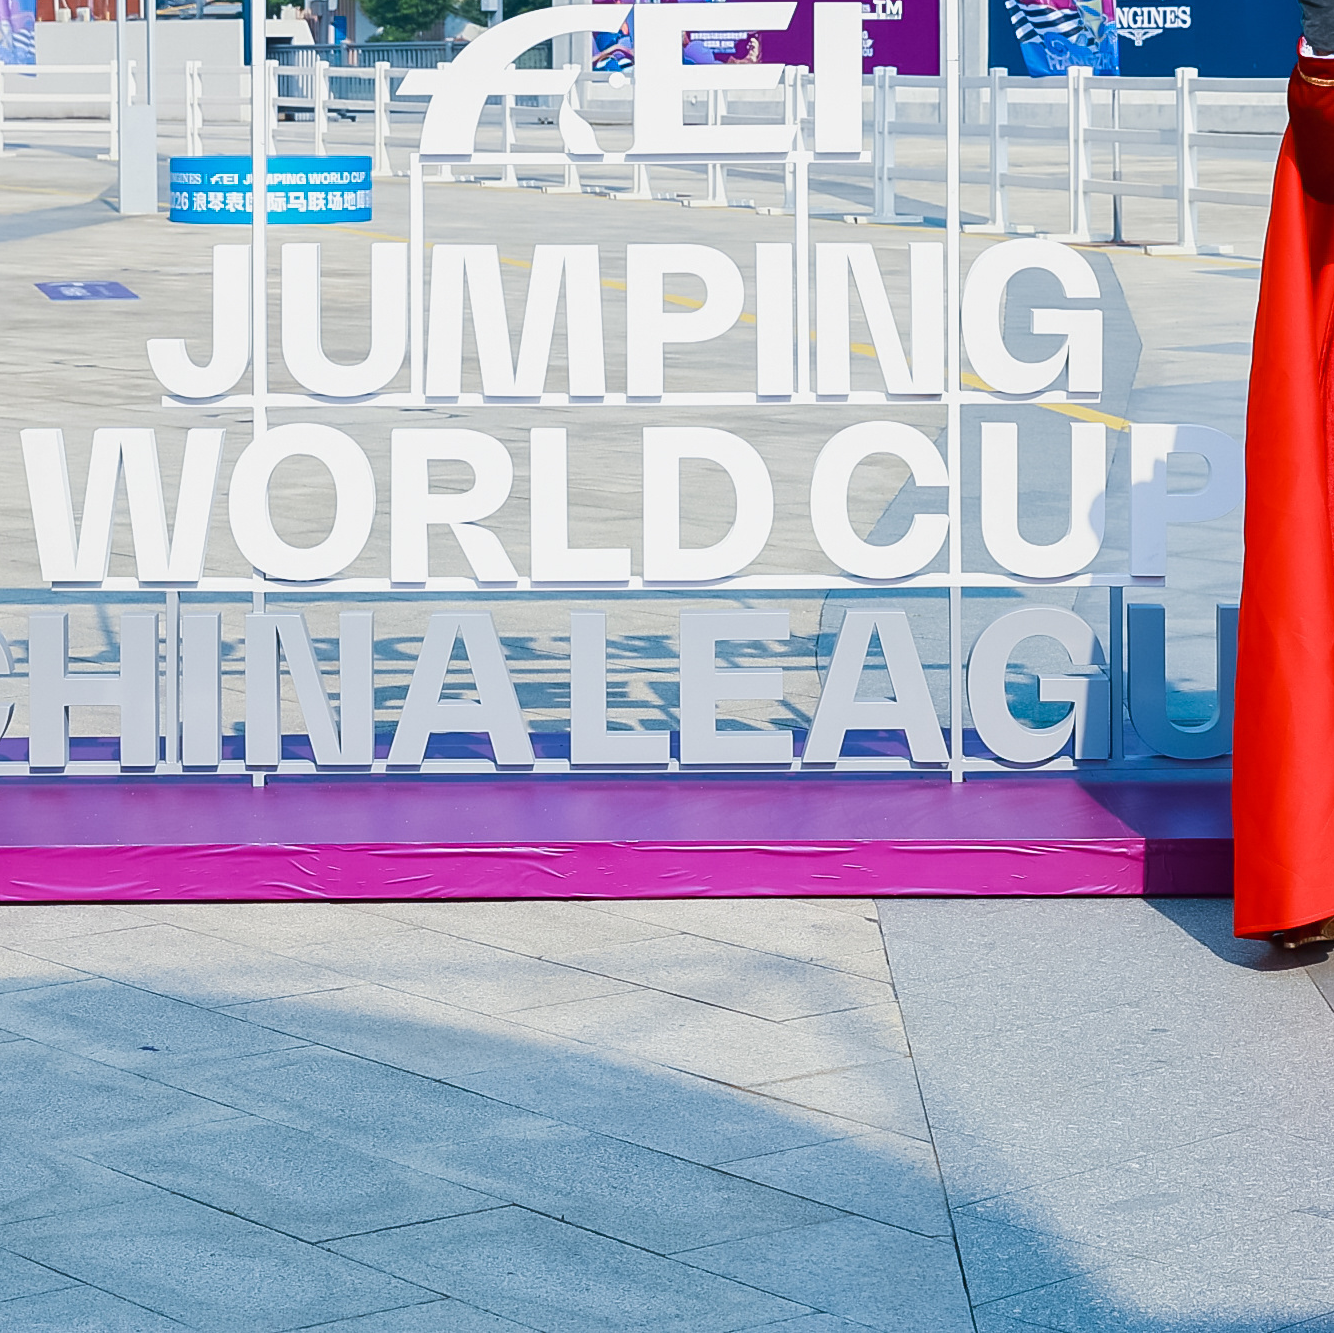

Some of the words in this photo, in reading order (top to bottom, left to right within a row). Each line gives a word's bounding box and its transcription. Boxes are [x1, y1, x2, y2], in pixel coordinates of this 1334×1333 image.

[1115, 6, 1191, 28] NGINES
[243, 173, 306, 185] JMPING
[308, 172, 350, 185] WORLD
[351, 171, 366, 183] CUP
[147, 237, 1103, 398] JUMPING
[19, 422, 775, 583] WORLD
[809, 420, 1245, 579] CUP
[571, 603, 1239, 767] LEAGU
